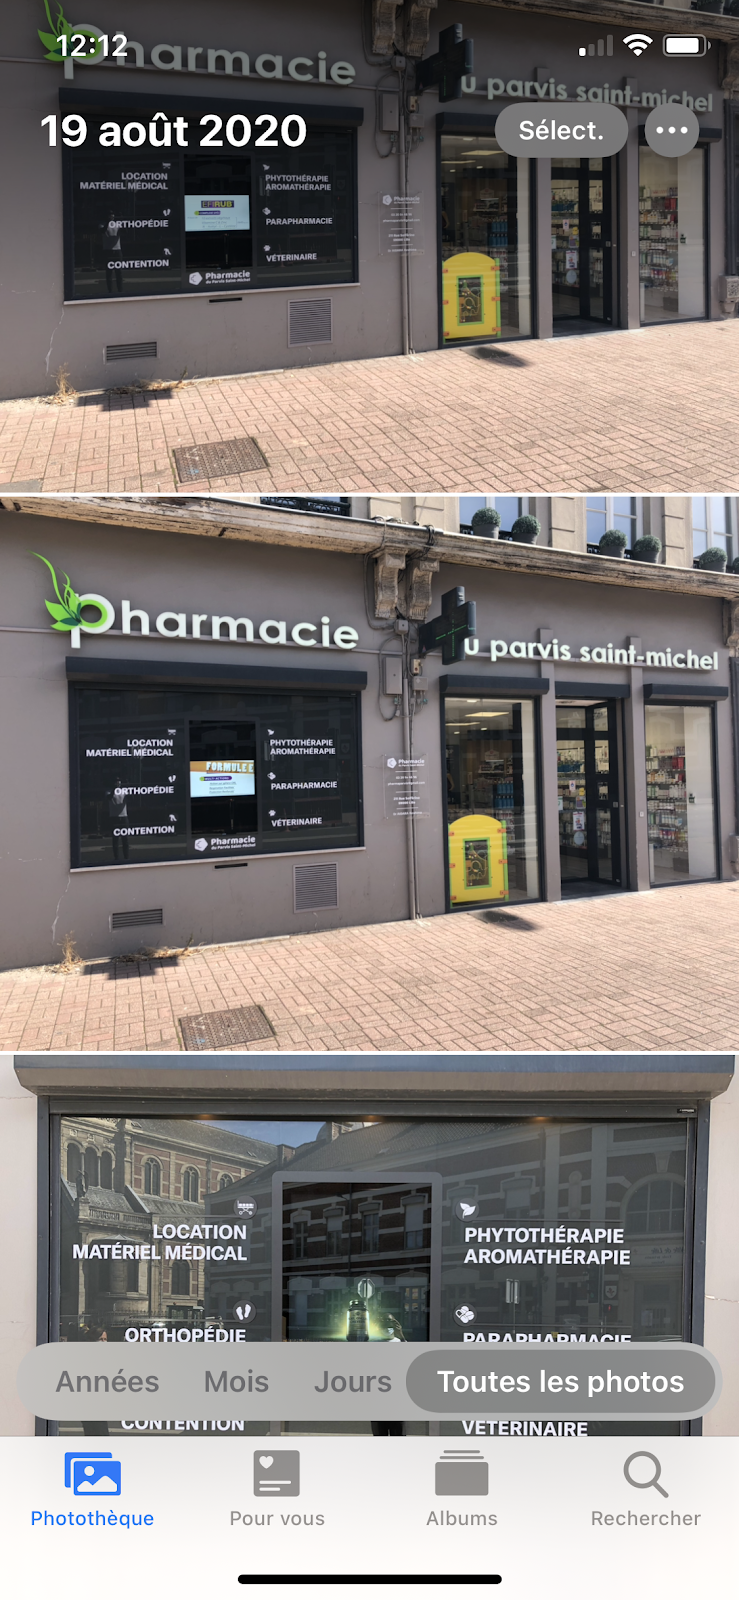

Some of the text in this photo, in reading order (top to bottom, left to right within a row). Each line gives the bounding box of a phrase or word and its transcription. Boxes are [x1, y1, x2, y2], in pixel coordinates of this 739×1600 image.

[487, 77, 568, 100] parvis
[576, 84, 713, 112] saint-michel
[121, 172, 168, 181] LOCATION
[265, 173, 329, 183] PHYTOTHÉRAPIE
[79, 181, 168, 191] MATÉRIEL MÉDICAL
[265, 182, 332, 192] AROMATHÉRAPIE
[108, 218, 169, 229] ORTHOPÉDIE
[266, 216, 333, 226] PARAPHARMACIE
[107, 259, 169, 269] CONTENTION
[206, 270, 250, 280] Pharmacie
[490, 638, 572, 662] parvis
[579, 643, 719, 671] saint-michel
[127, 738, 173, 748] LOCATION
[270, 737, 334, 747] PHYTOTHÉRAPIE
[86, 747, 174, 758] MATÉRIEL MÉDICAL
[270, 746, 336, 756] AROMATHÉRAPIE
[206, 762, 247, 772] FORMULE
[114, 784, 175, 796] ORTHOPÉDIE
[271, 780, 338, 790] PARAPHARMACIE
[113, 825, 175, 837] CONTENTION
[211, 836, 256, 845] Pharmacie
[153, 1223, 247, 1240] LOCATION
[464, 1225, 624, 1244] PHYTOTHÉRAPIE
[72, 1241, 247, 1261] MATÉRIEL MÉDICAL
[463, 1246, 631, 1266] AROMATHÉRAPIE
[124, 1326, 246, 1342] ORTHOPÉDIE
